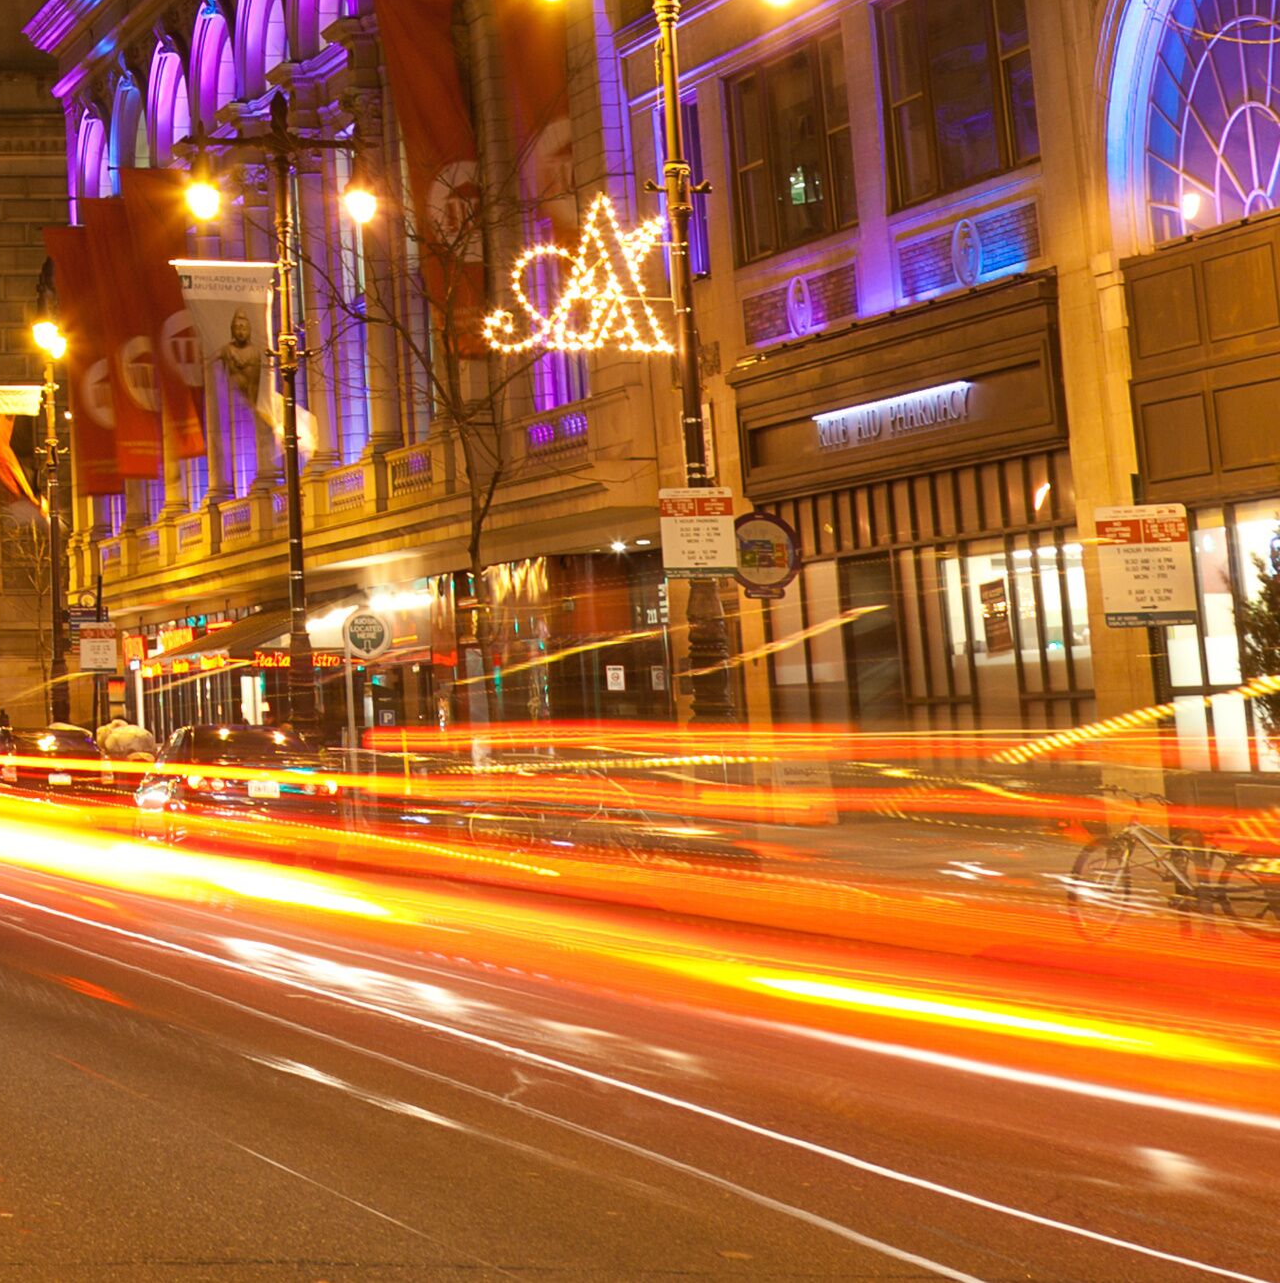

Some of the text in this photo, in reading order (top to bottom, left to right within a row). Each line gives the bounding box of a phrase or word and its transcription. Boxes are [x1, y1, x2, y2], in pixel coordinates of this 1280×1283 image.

[194, 275, 258, 284] PHILADELPHIA
[194, 283, 233, 291] MUSEUM
[817, 386, 972, 448] RITE AID PHARMACY
[312, 652, 341, 667] istro
[383, 713, 393, 724] P
